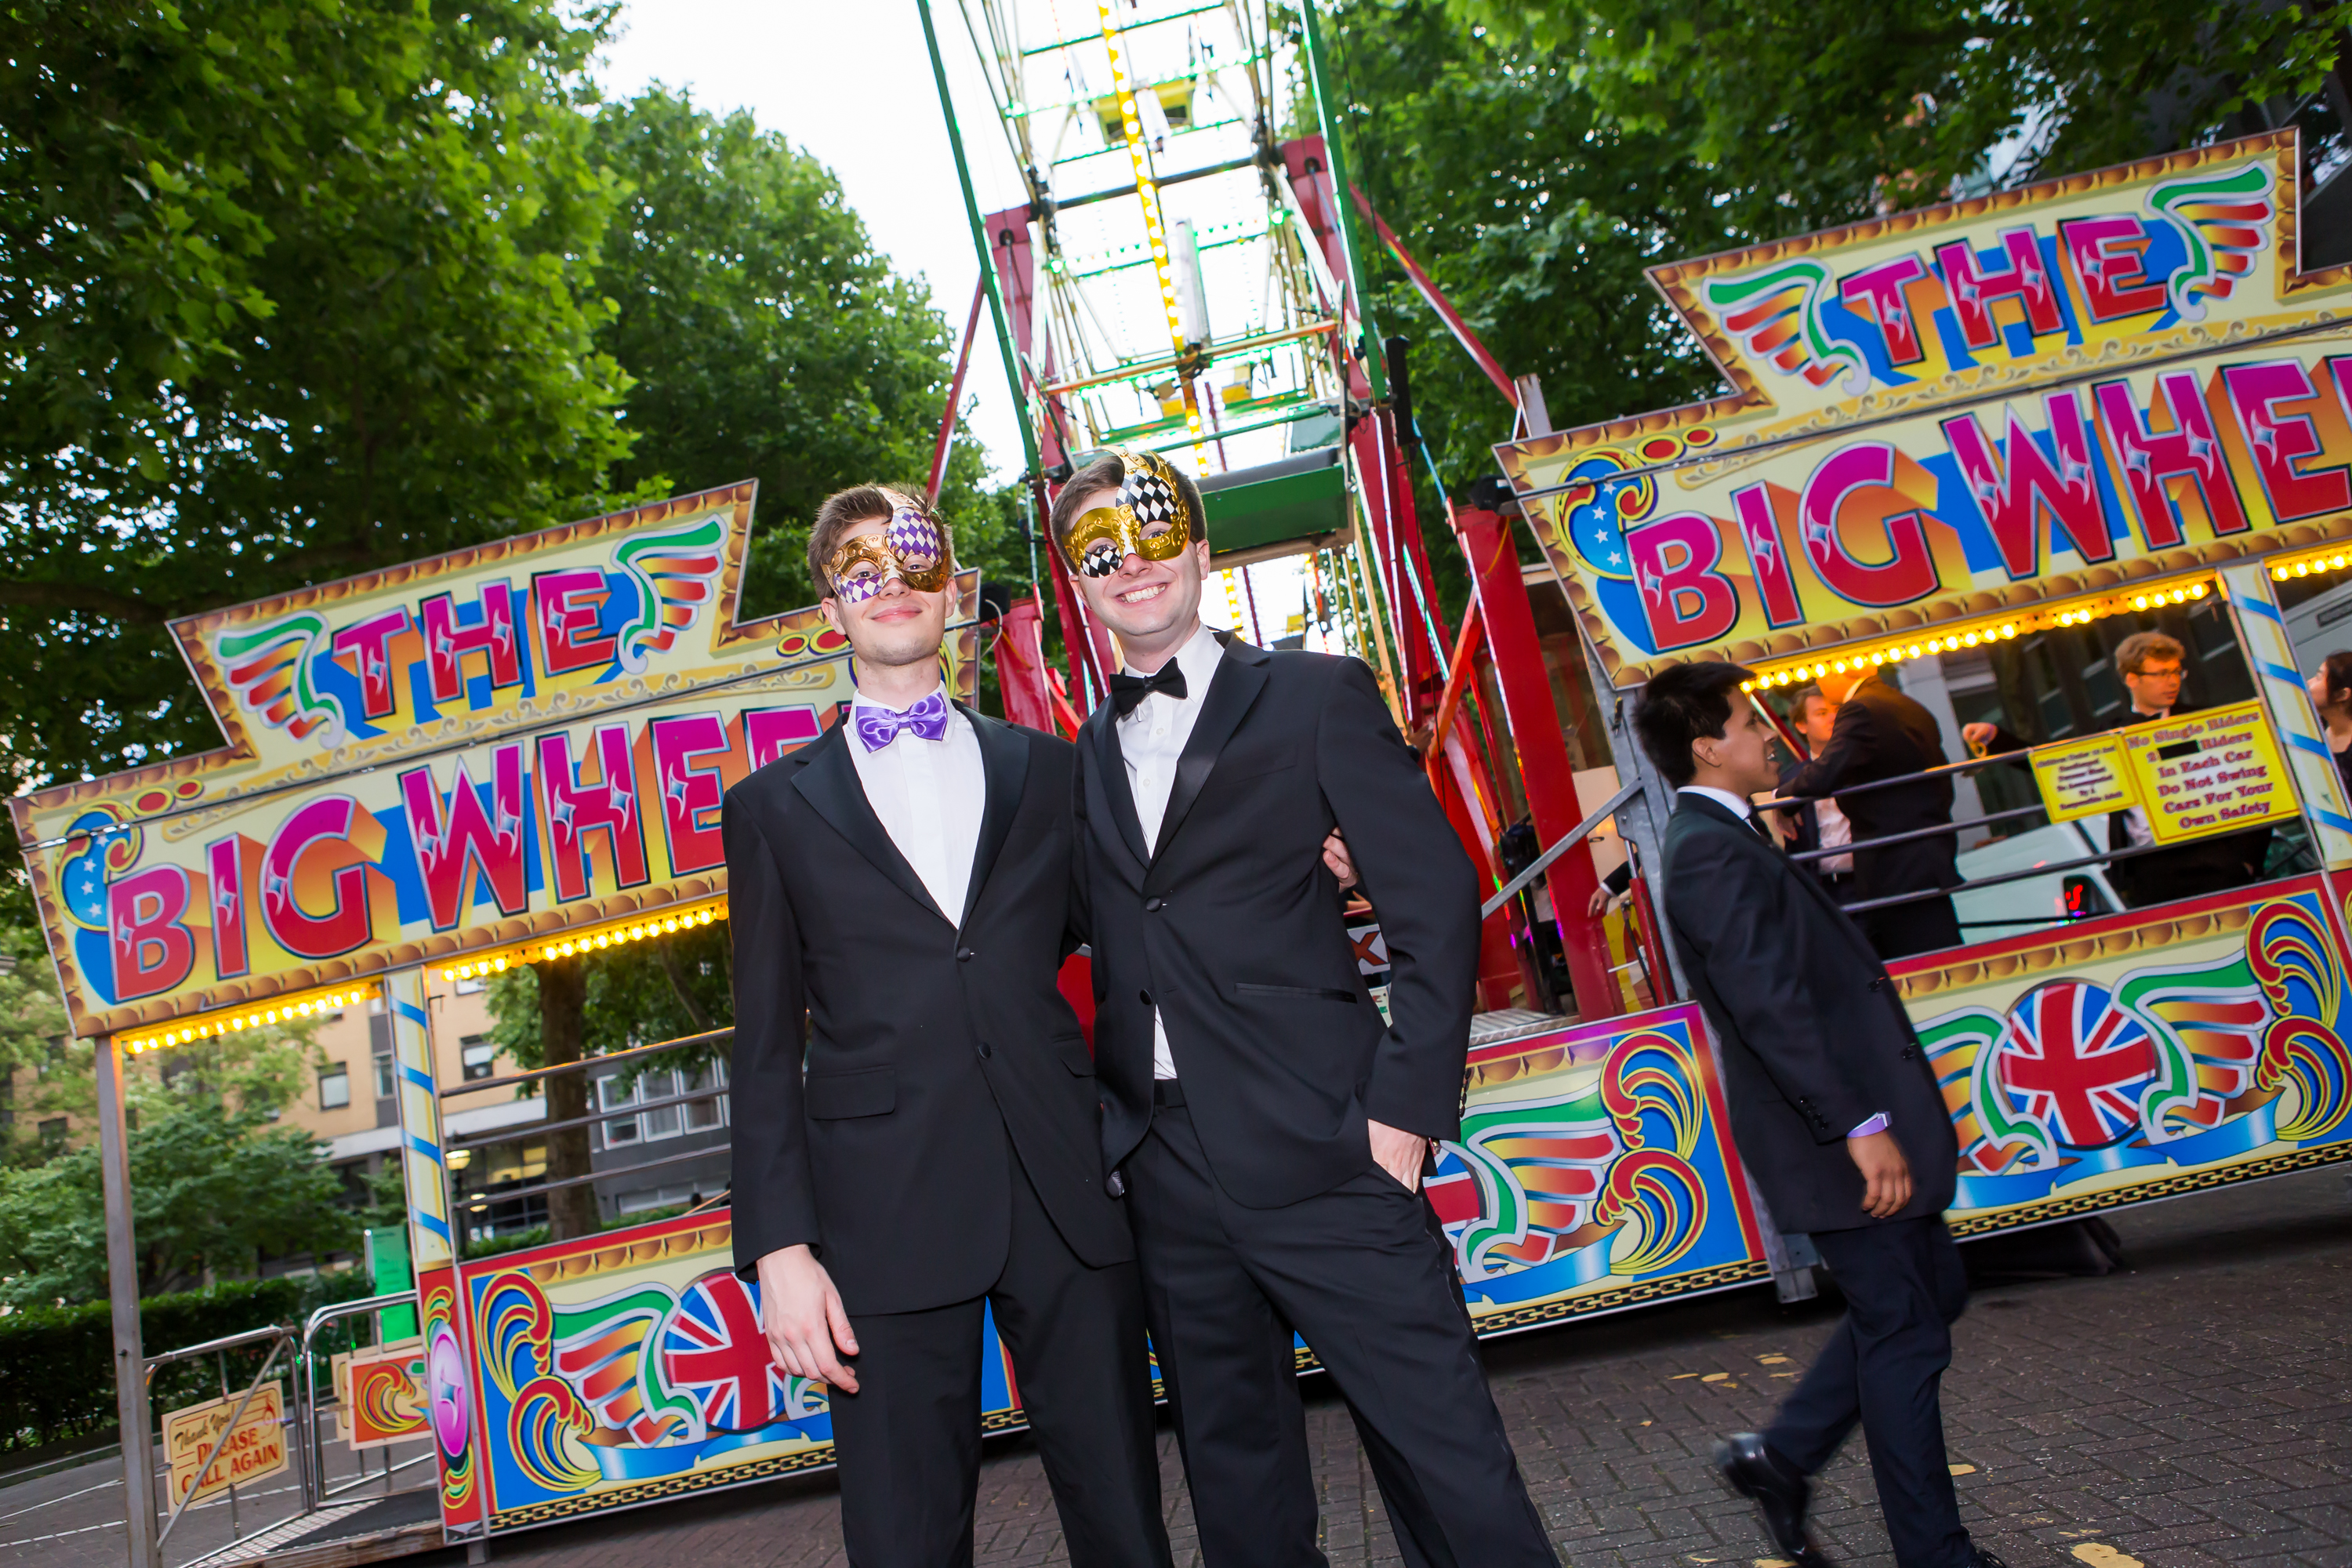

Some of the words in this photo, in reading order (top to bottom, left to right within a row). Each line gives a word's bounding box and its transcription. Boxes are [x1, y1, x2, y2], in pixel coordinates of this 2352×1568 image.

[1837, 212, 2169, 368] THE
[1624, 440, 1940, 652] BIG
[331, 564, 619, 723] THE
[2126, 735, 2150, 749] No
[2154, 724, 2204, 742] Single
[2206, 711, 2259, 731] Riders
[2146, 751, 2158, 763] 2
[2200, 731, 2252, 750] Riders
[2158, 767, 2177, 779] In
[2180, 756, 2220, 773] Each
[2224, 750, 2252, 764] Car
[2158, 785, 2180, 797] Do
[2183, 775, 2214, 792] Not
[2217, 765, 2267, 783] Swing
[2164, 799, 2201, 814] Cars
[2205, 792, 2233, 805] For
[2236, 782, 2274, 797] Your
[2180, 814, 2216, 829] Own
[2220, 801, 2270, 821] Safety
[107, 793, 375, 1005] BIG
[230, 1443, 279, 1478] AGAIN
